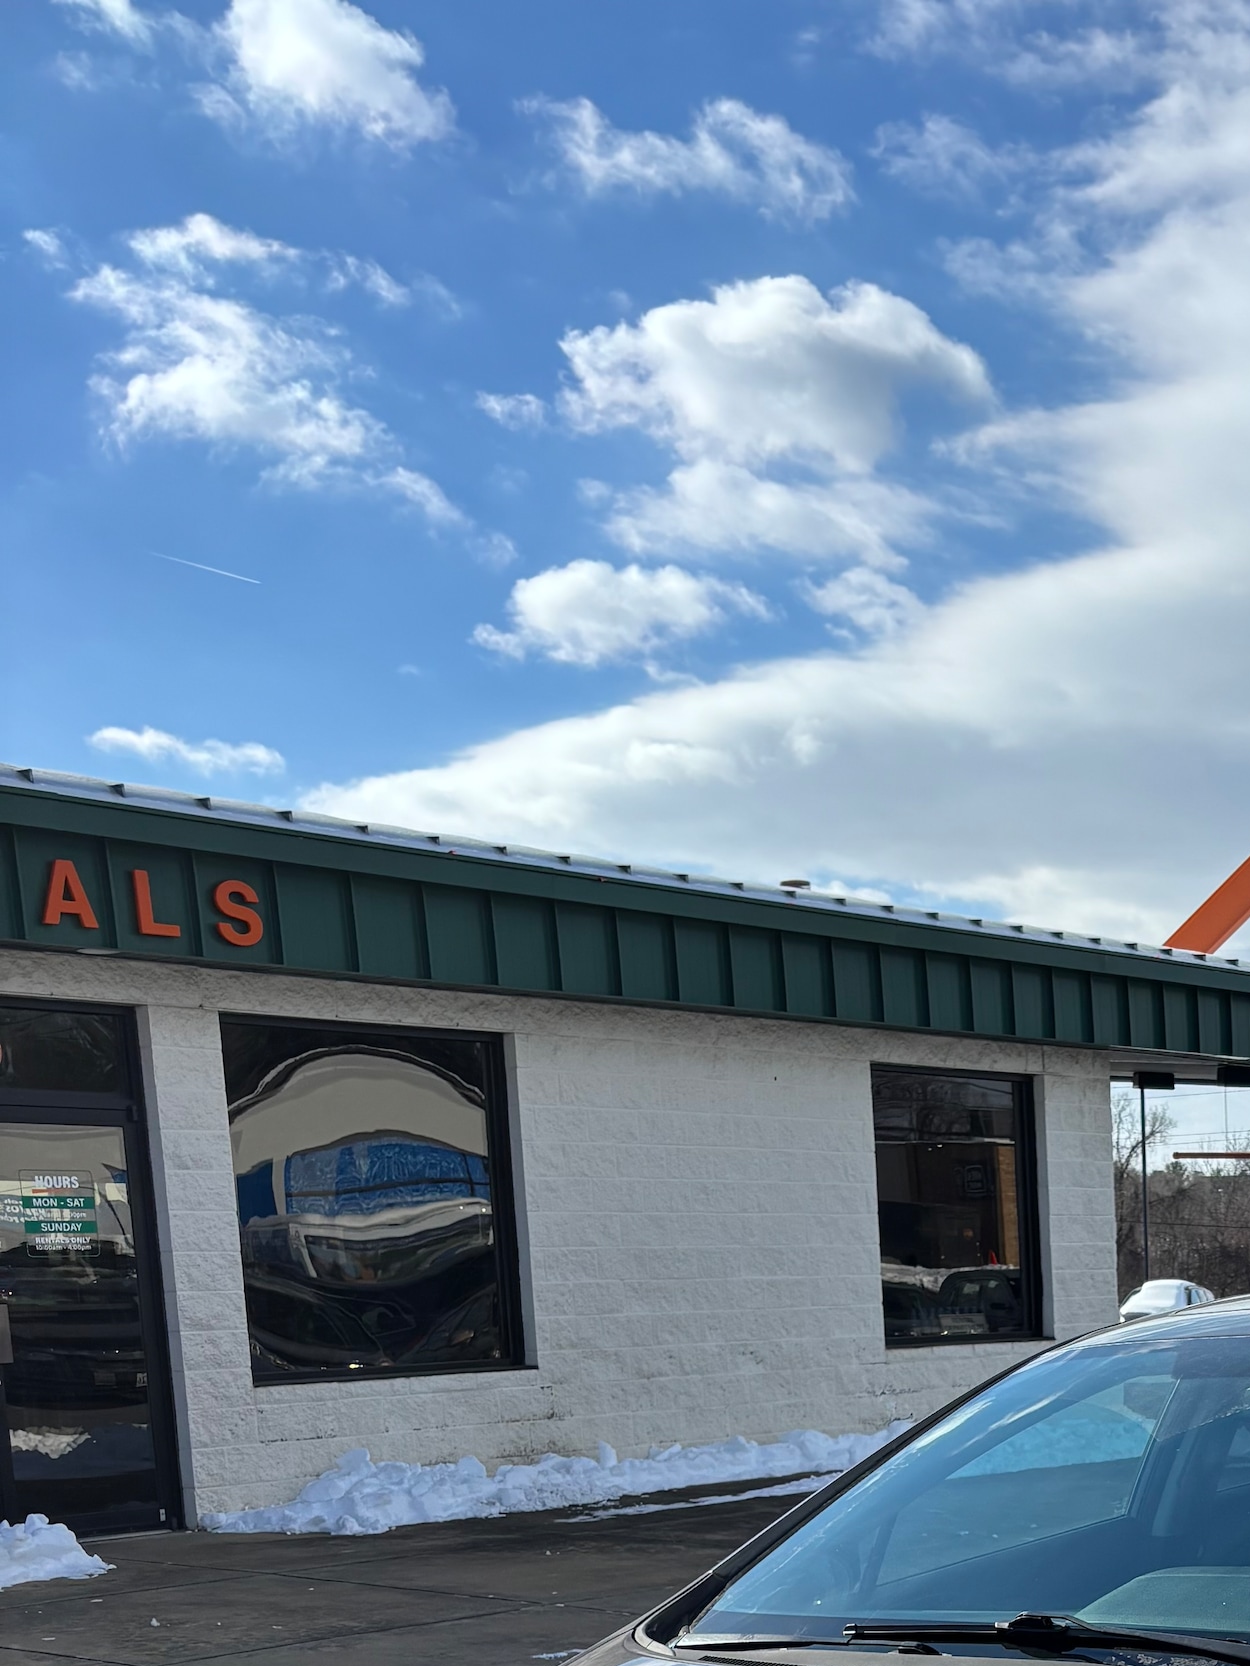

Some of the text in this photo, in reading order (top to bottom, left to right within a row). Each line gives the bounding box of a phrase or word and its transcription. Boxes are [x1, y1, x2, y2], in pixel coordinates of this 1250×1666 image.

[42, 859, 264, 947] ALS
[34, 1175, 80, 1189] HOURS
[32, 1198, 58, 1207] MON
[67, 1198, 85, 1207] SAT
[41, 1222, 82, 1232] SUNDAY
[70, 1236, 91, 1244] ONLY
